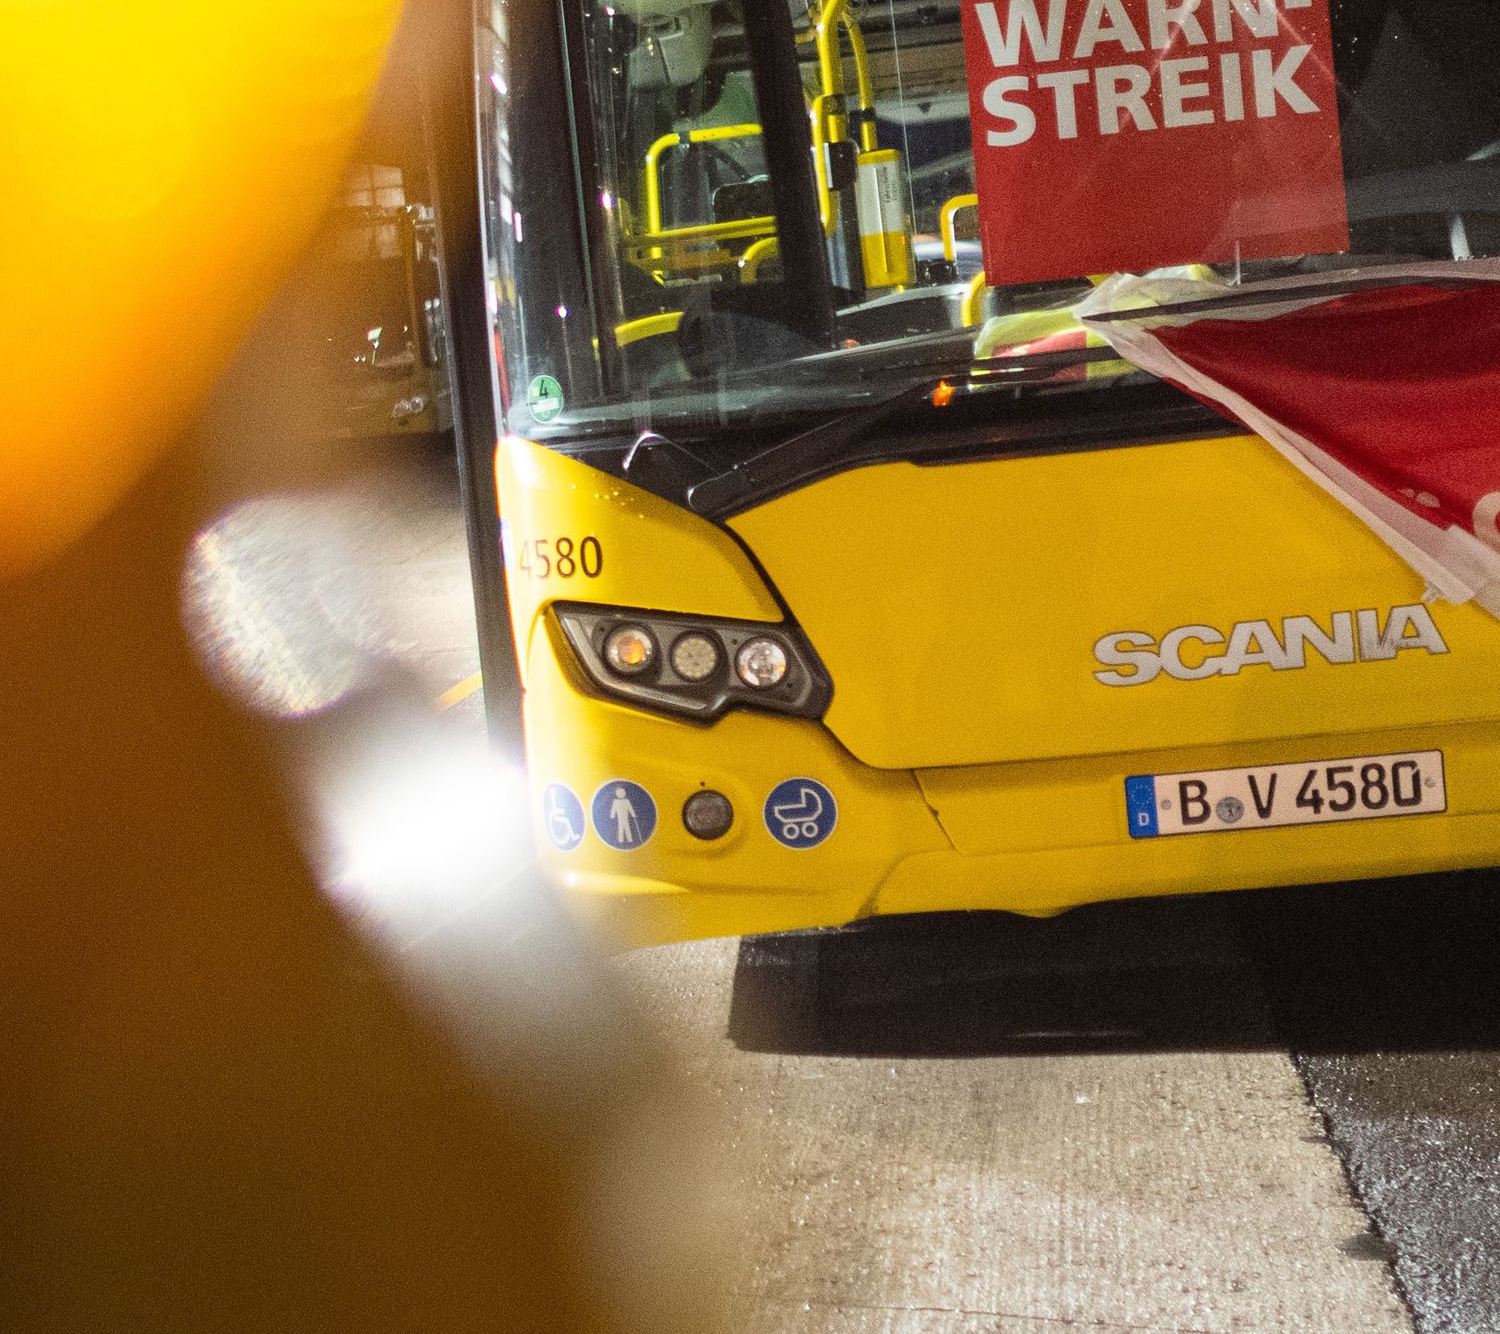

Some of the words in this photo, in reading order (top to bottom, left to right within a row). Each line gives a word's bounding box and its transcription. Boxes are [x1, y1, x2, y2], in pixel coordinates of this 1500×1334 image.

[982, 44, 1321, 147] STREIK
[519, 535, 604, 581] 4580
[1093, 603, 1450, 687] SCANIA
[1138, 811, 1149, 827] D
[1178, 779, 1212, 827] B
[1247, 772, 1278, 820] V
[1295, 760, 1423, 815] 4580
